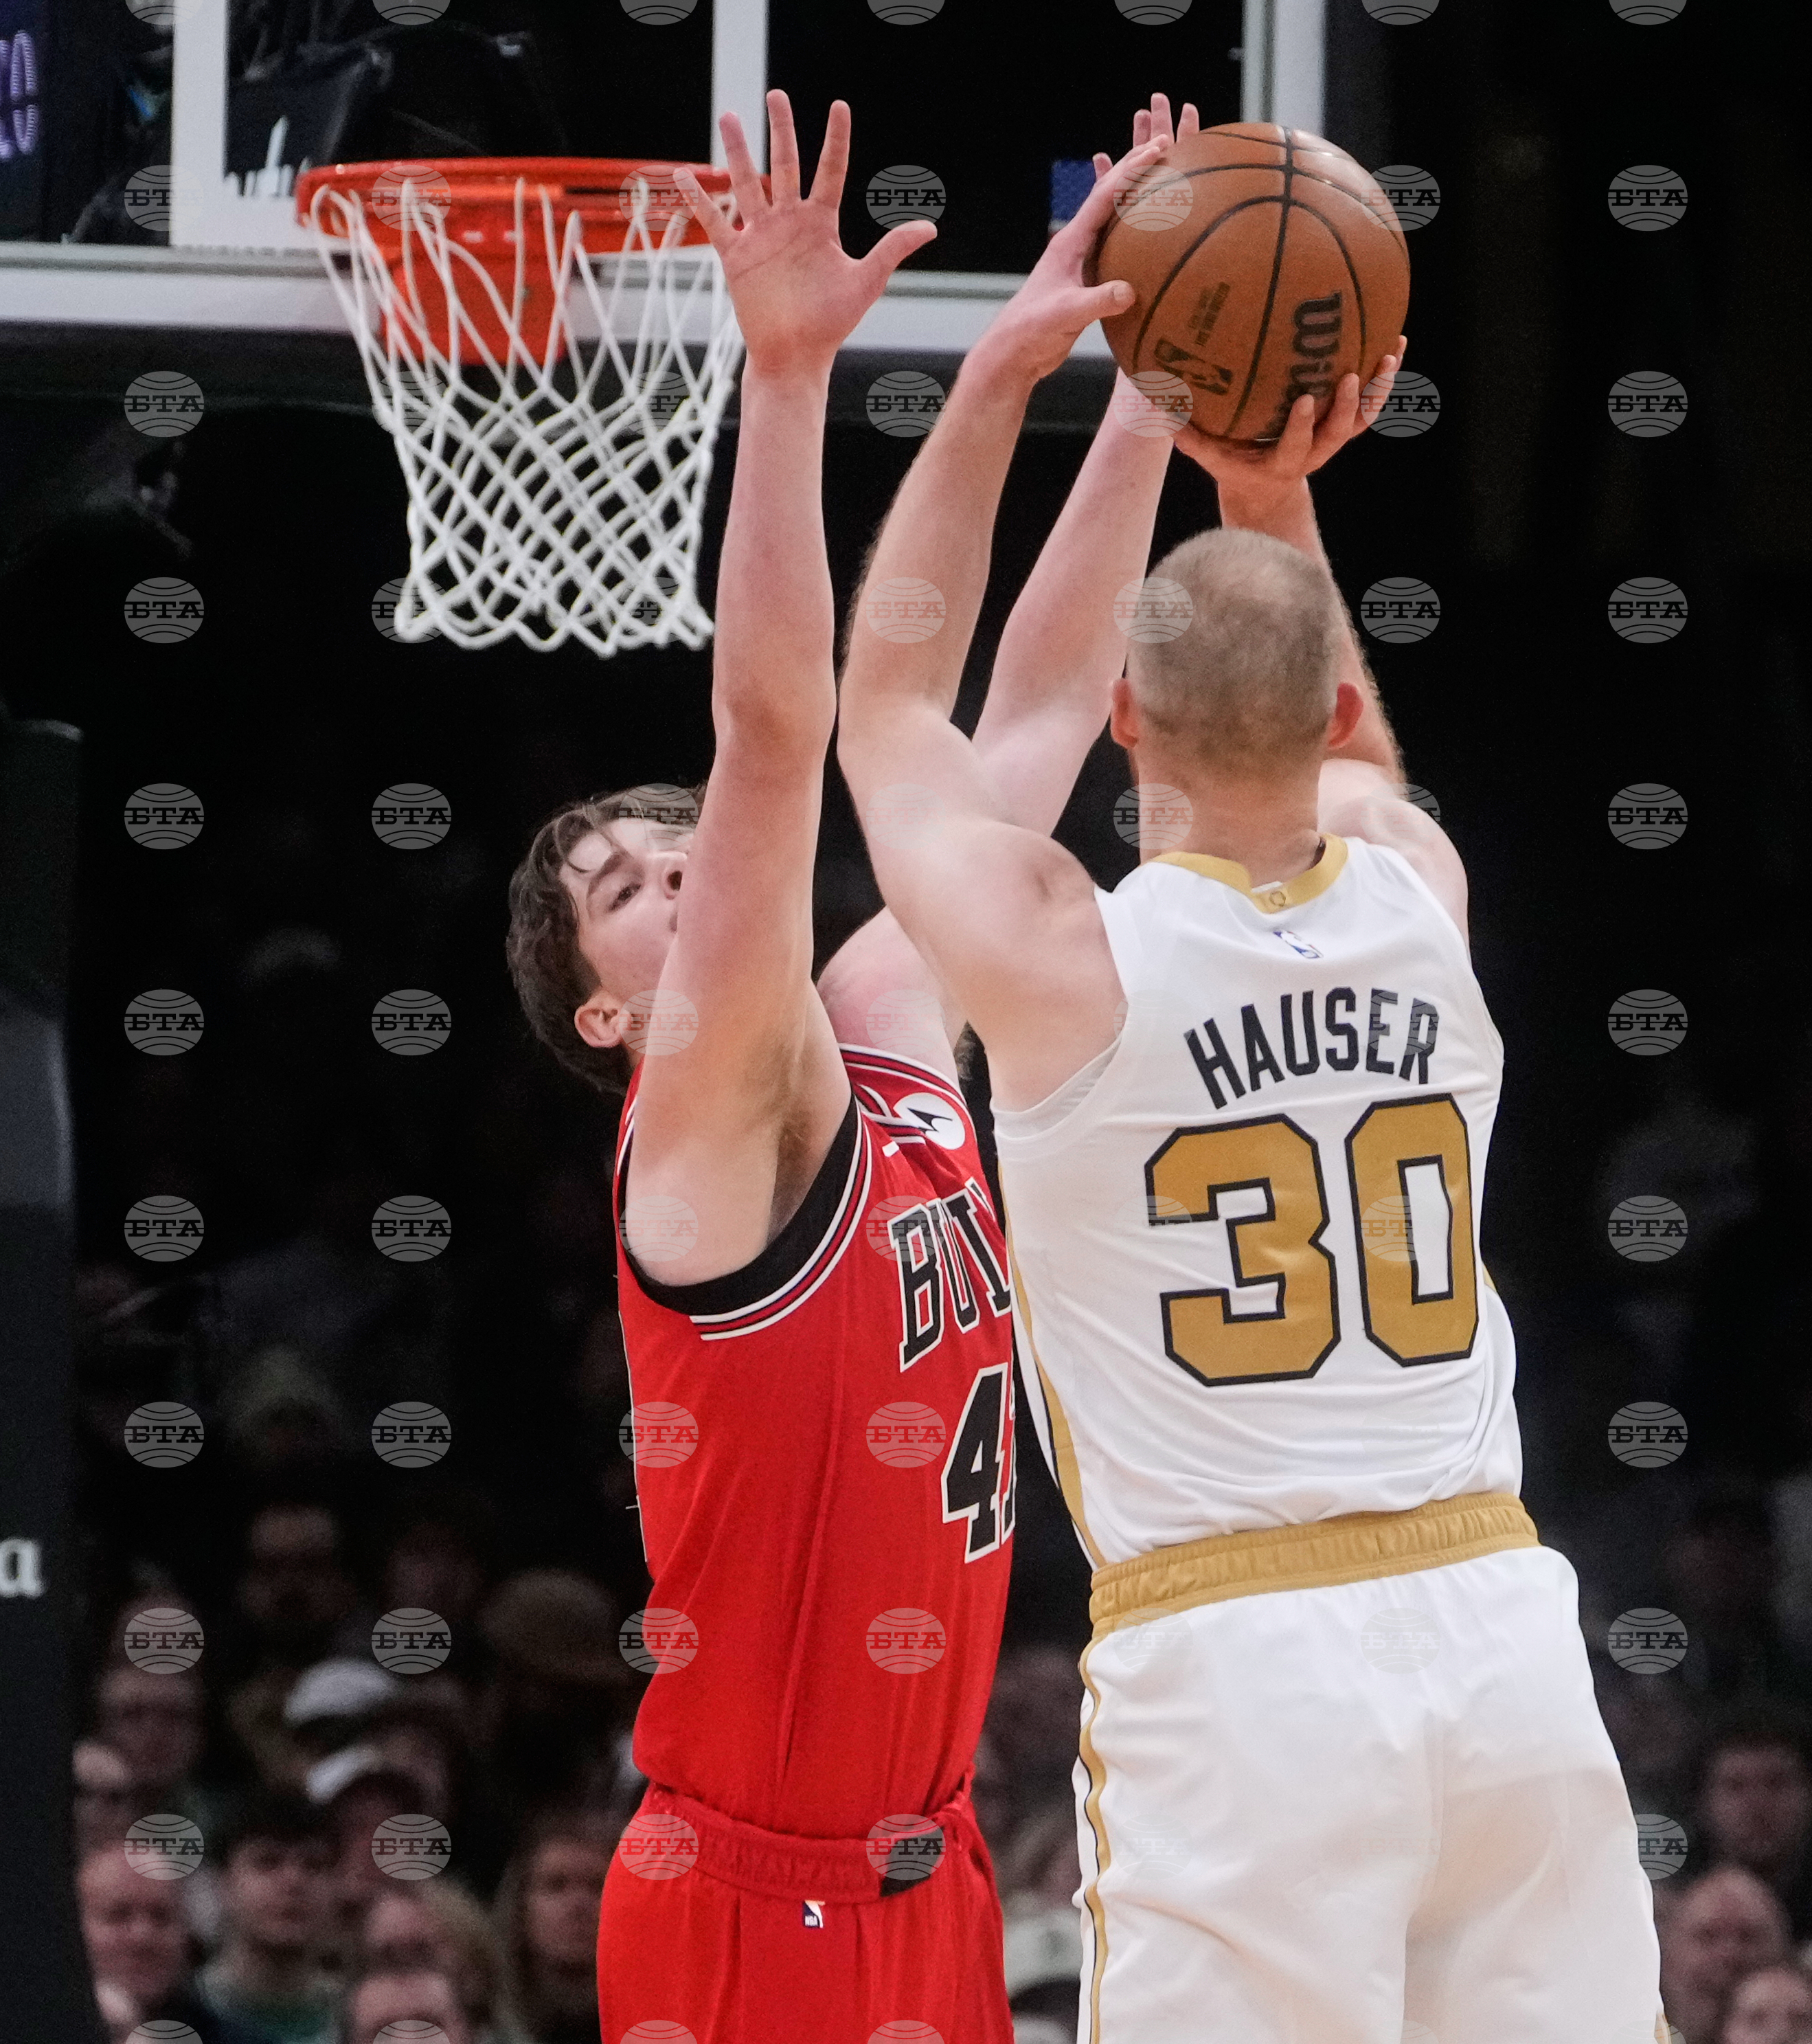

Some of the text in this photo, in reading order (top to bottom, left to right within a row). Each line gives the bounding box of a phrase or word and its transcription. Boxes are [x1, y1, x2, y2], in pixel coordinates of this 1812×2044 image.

[1184, 987, 1440, 1109] HAUSER
[1144, 1093, 1480, 1387] 30
[940, 1362, 1017, 1564] 4
